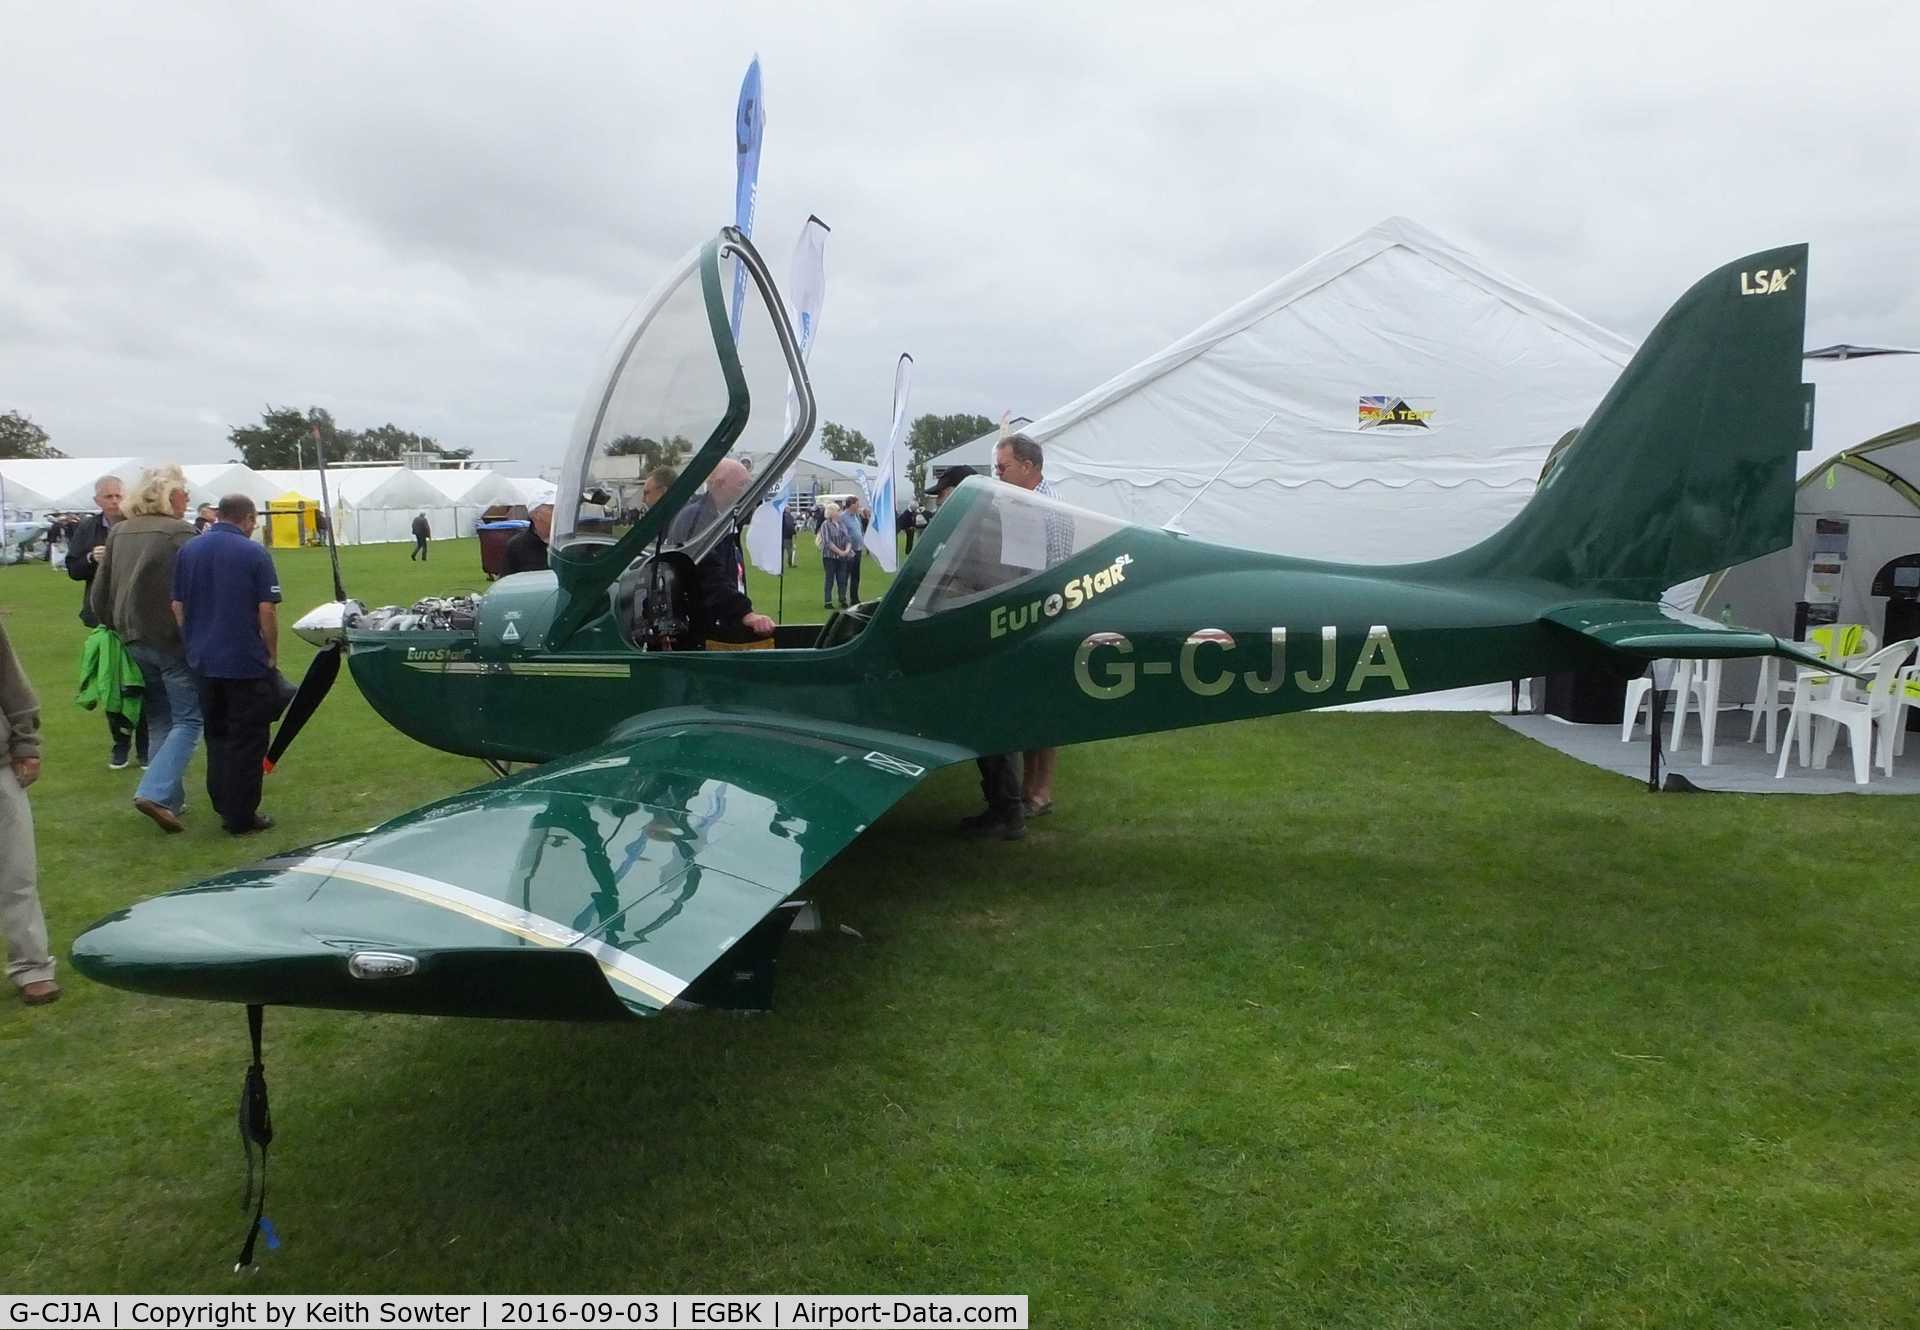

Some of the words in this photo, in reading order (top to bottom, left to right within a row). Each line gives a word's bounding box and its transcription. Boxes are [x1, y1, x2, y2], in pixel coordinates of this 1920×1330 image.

[1740, 269, 1788, 296] LSA
[1399, 410, 1436, 420] TENT
[1074, 625, 1410, 700] G-CJJA
